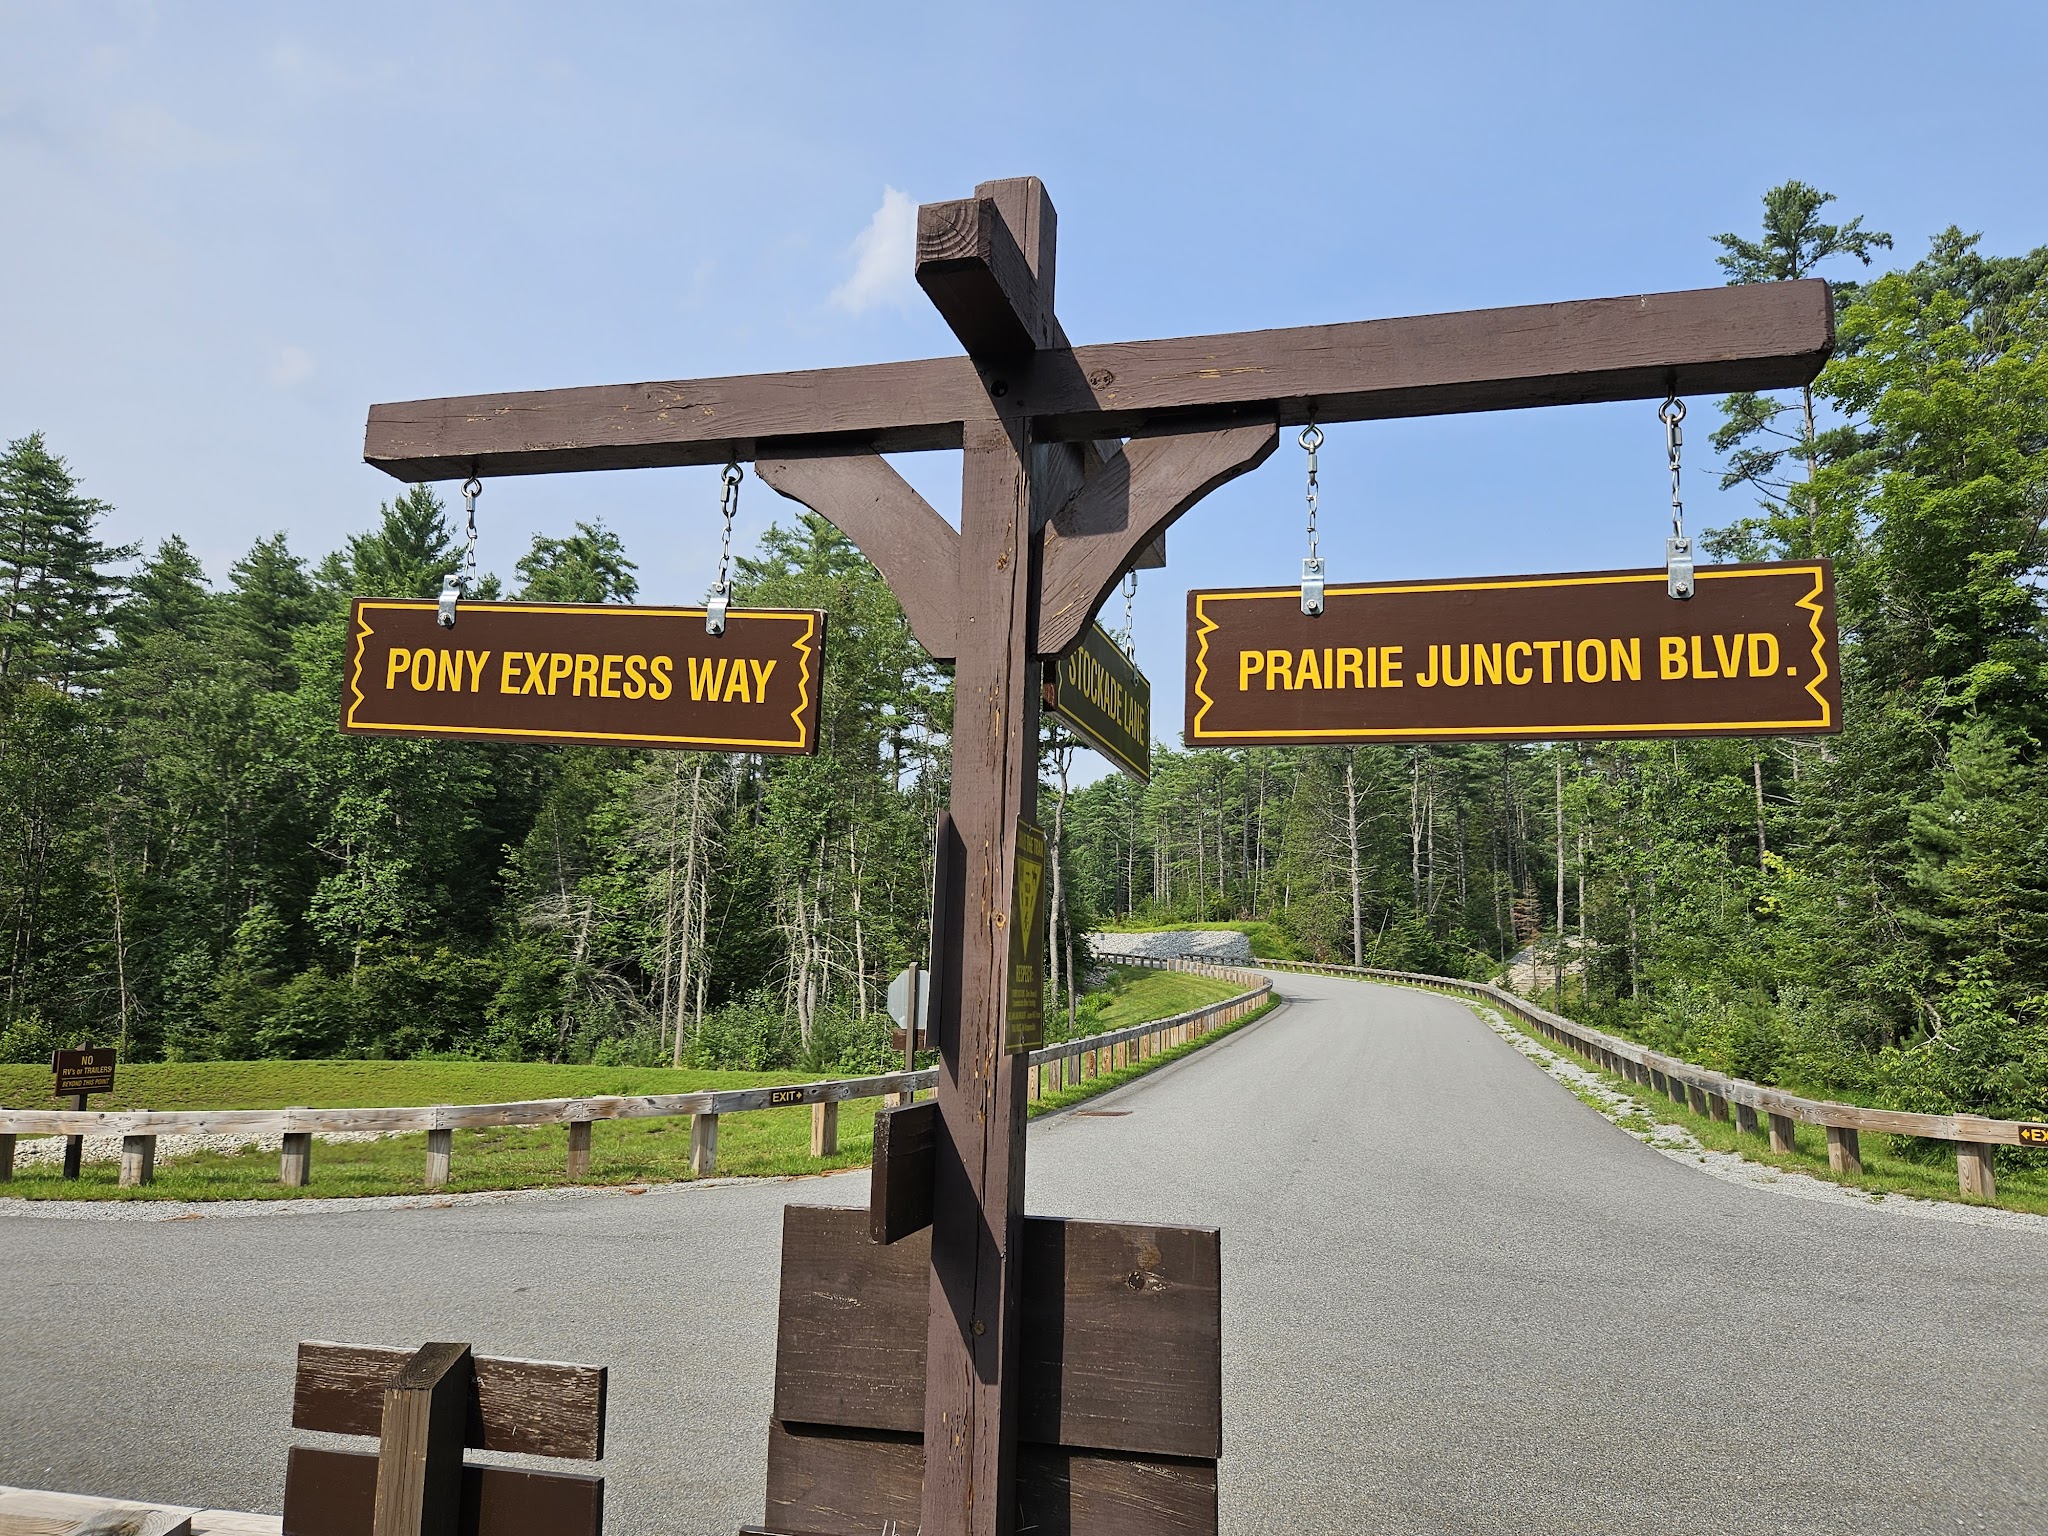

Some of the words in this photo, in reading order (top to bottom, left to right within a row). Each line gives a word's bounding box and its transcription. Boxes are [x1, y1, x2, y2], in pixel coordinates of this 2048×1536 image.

[1239, 646, 1404, 692] PRAIRIE
[1416, 638, 1642, 688] JUNCTION
[1659, 632, 1798, 680] BLVD.
[385, 648, 491, 693] PONY
[500, 651, 673, 701] EXPRESS
[687, 657, 777, 704] WAY
[1068, 645, 1123, 727] STOCKADE
[1124, 690, 1145, 747] LANE
[81, 1055, 94, 1066] NO
[62, 1068, 76, 1076] RV's
[84, 1065, 112, 1075] TRAILERS
[772, 1090, 796, 1103] EXIT
[2031, 1129, 2048, 1142] EX
